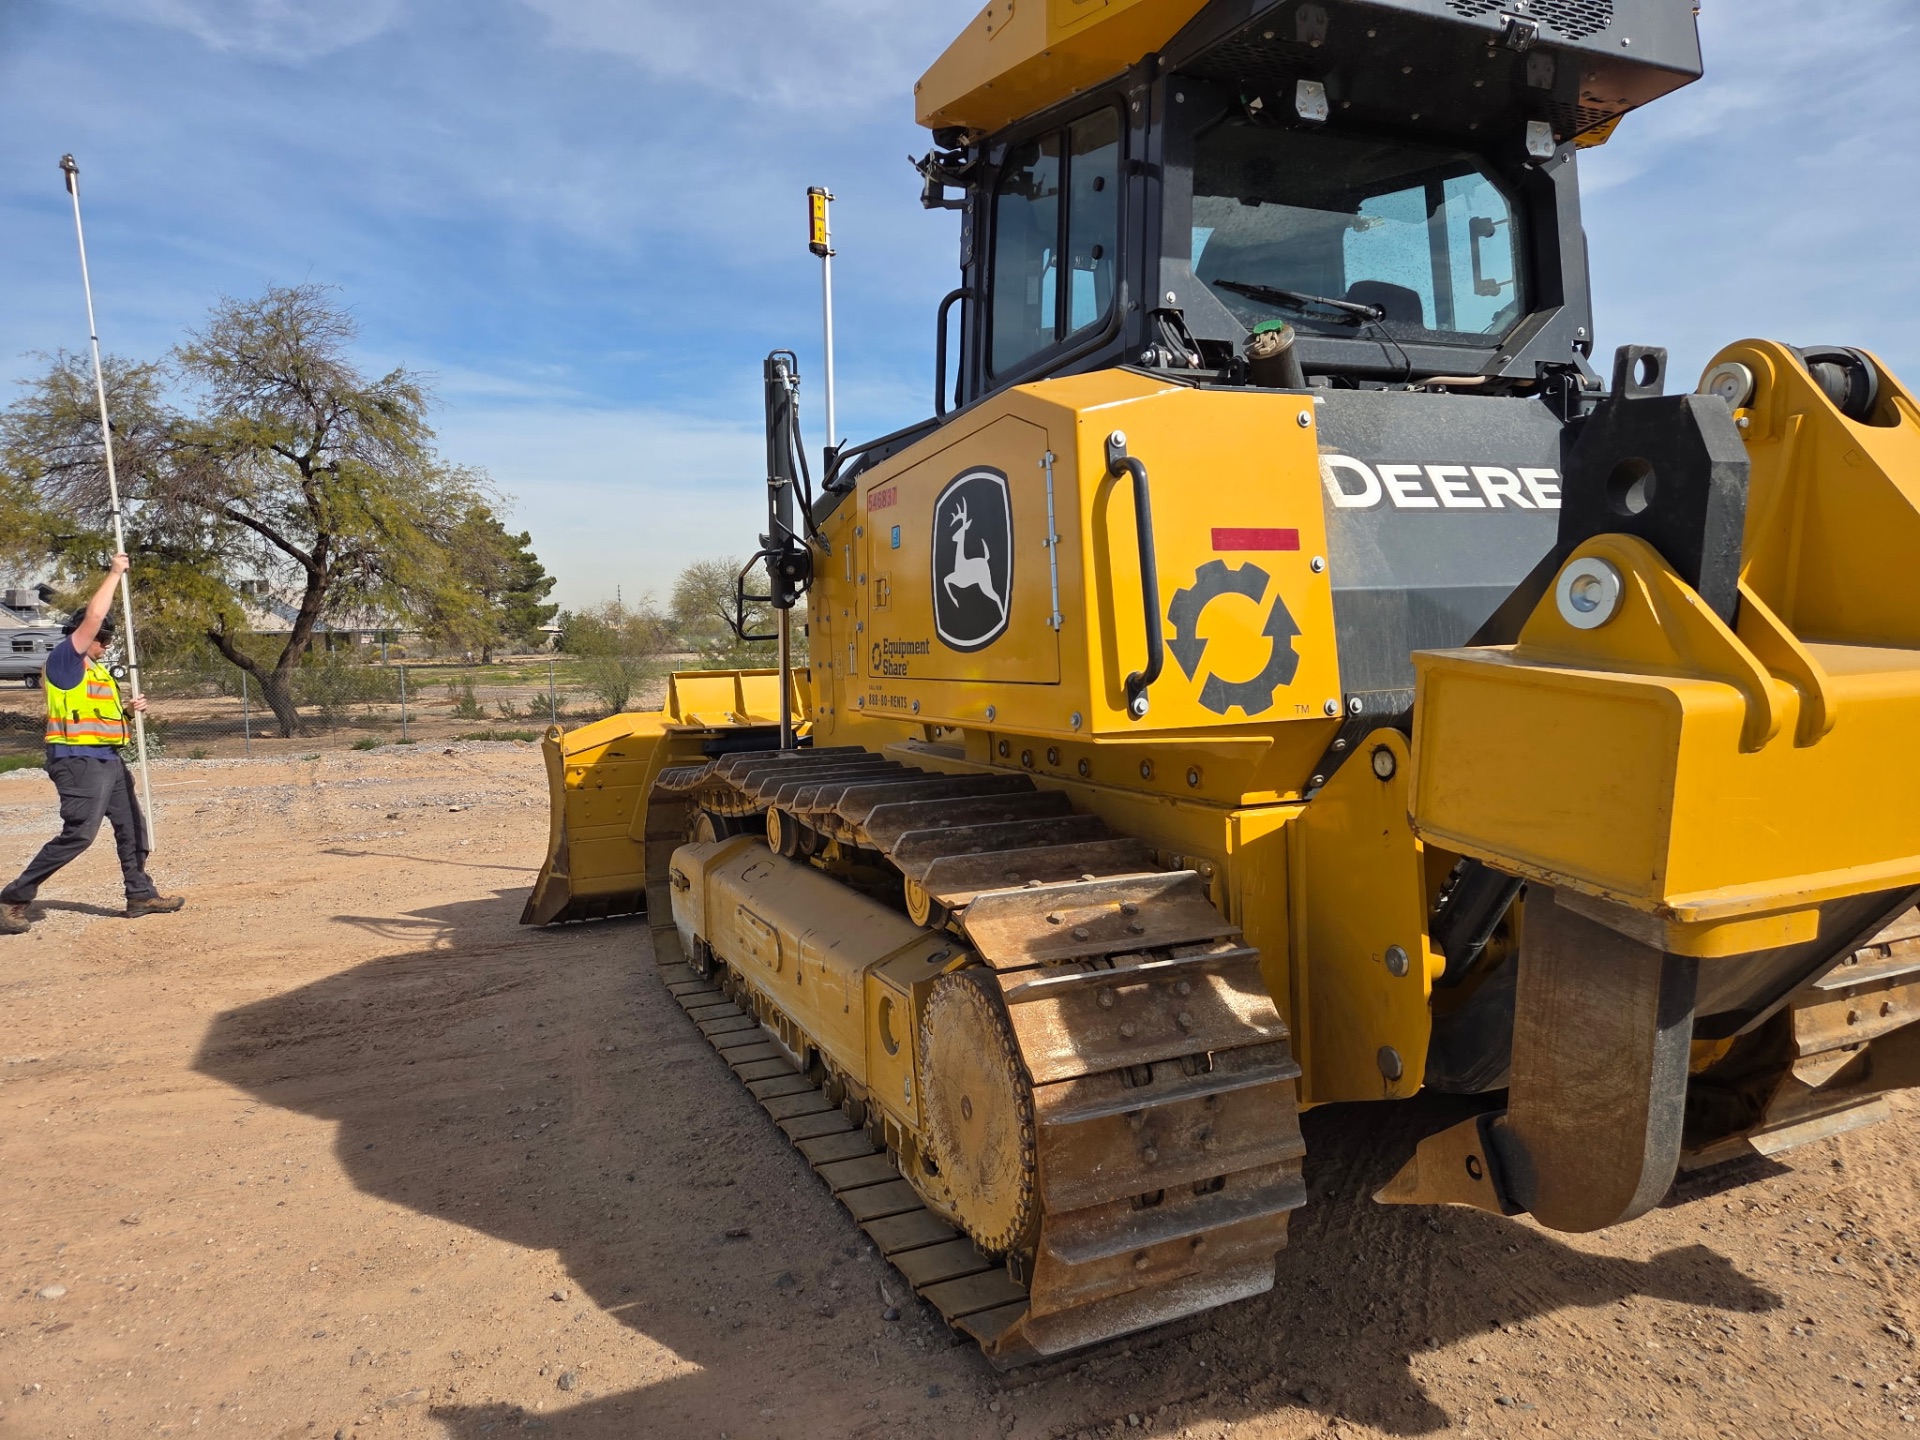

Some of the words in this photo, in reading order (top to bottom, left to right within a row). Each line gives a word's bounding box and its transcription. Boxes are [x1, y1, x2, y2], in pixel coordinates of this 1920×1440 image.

[1318, 454, 1562, 509] DEERE
[869, 487, 896, 512] 546837
[883, 637, 930, 658] Equipment
[1294, 704, 1310, 714] TM
